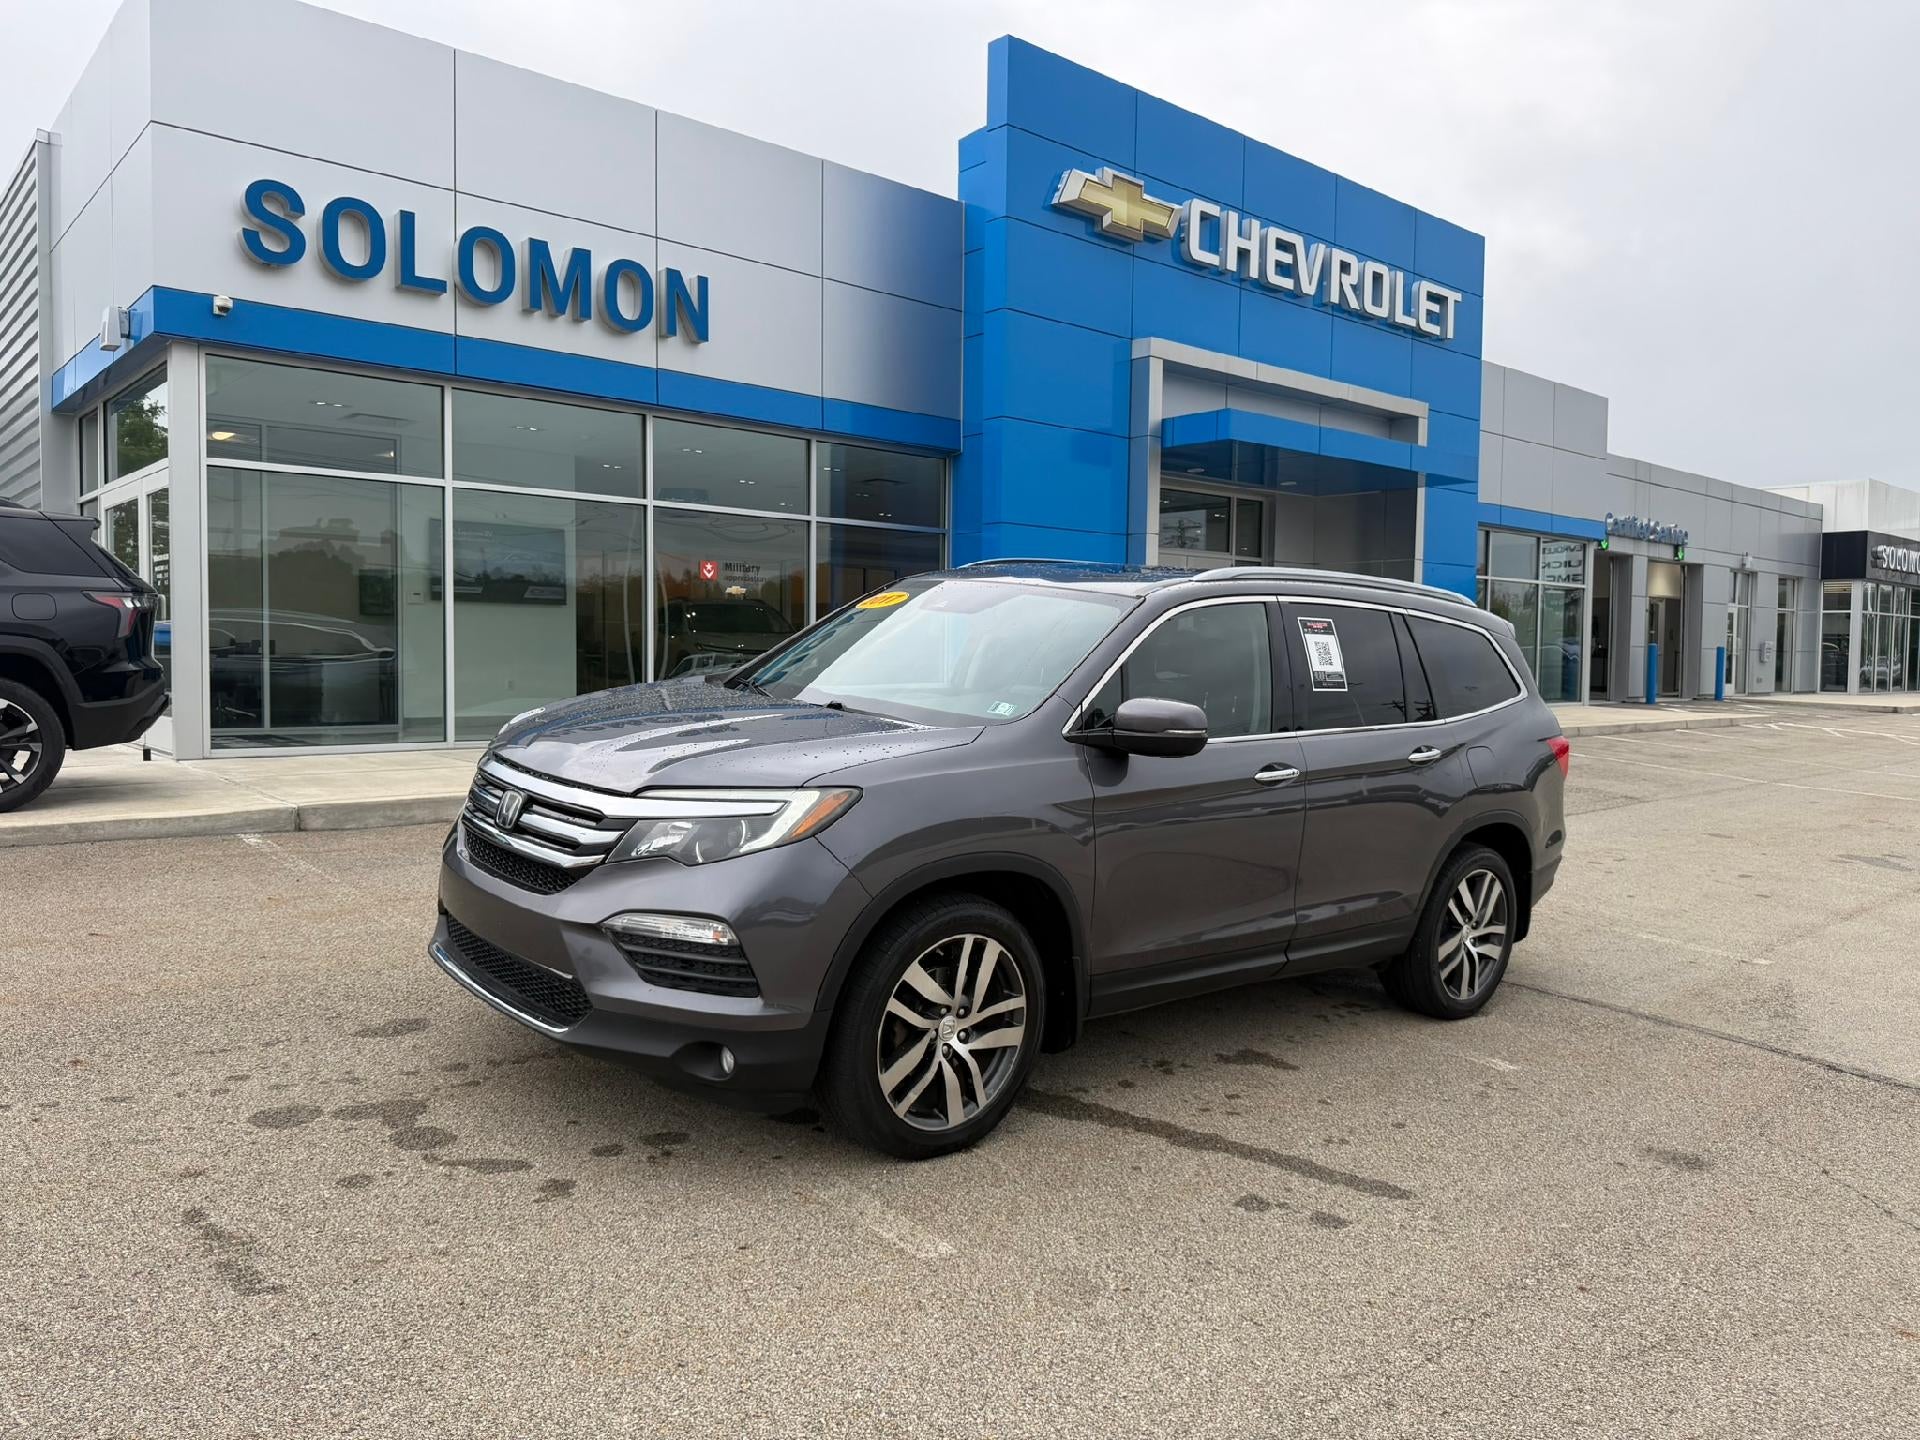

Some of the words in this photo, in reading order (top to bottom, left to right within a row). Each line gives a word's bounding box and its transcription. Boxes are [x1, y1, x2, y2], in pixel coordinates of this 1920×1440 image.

[241, 179, 709, 344] SOLOMON
[1182, 198, 1462, 340] CHEVROLET
[724, 562, 761, 576] Military
[1605, 512, 1650, 540] Certified
[1650, 521, 1688, 546] Service
